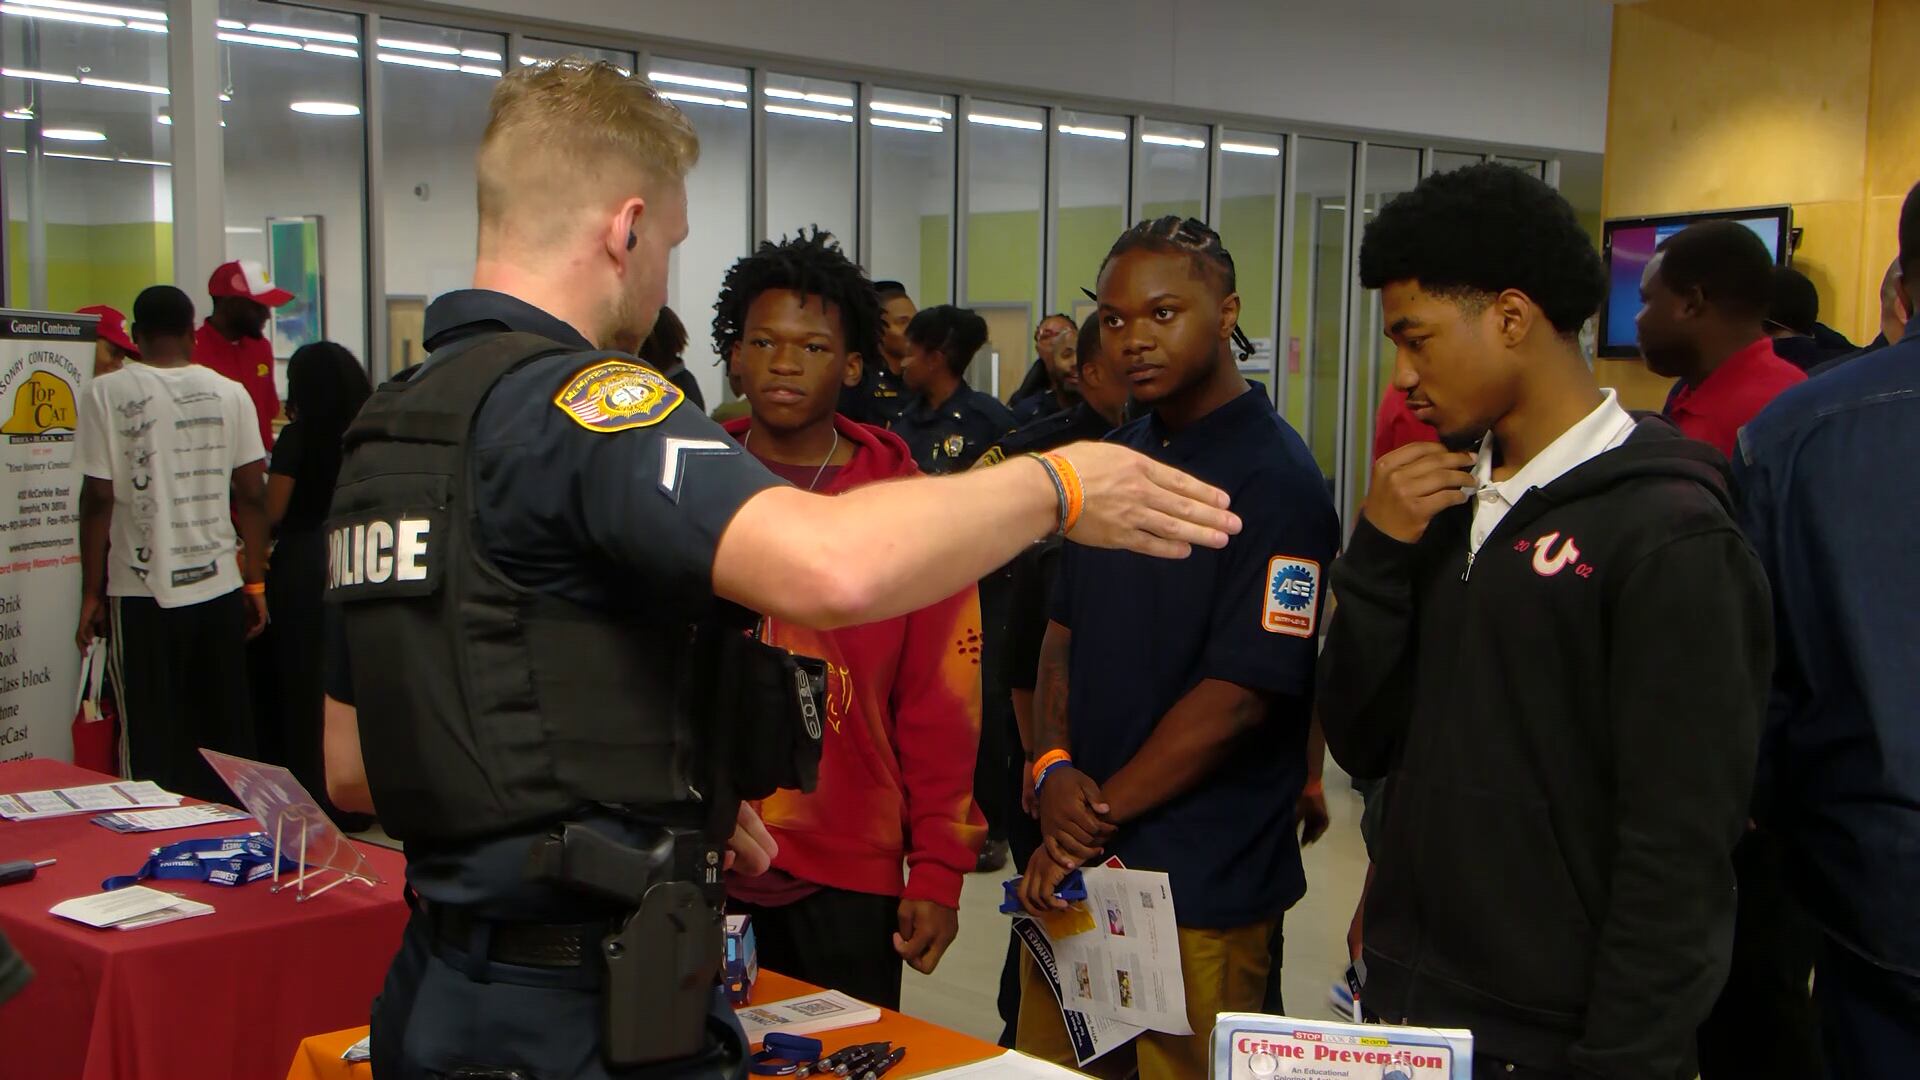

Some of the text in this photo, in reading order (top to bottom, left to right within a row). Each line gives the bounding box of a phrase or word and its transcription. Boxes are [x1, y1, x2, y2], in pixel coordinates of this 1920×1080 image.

[11, 320, 81, 336] General Contractor
[0, 357, 24, 396] SONRY
[1574, 563, 1593, 578] 02
[1278, 578, 1311, 597] ASE
[22, 666, 52, 688] block
[1023, 926, 1061, 985] SOUTHWEST
[1295, 1031, 1321, 1041] STOP
[1237, 1038, 1444, 1070] Crime Prevention
[1304, 1067, 1349, 1077] Educational
